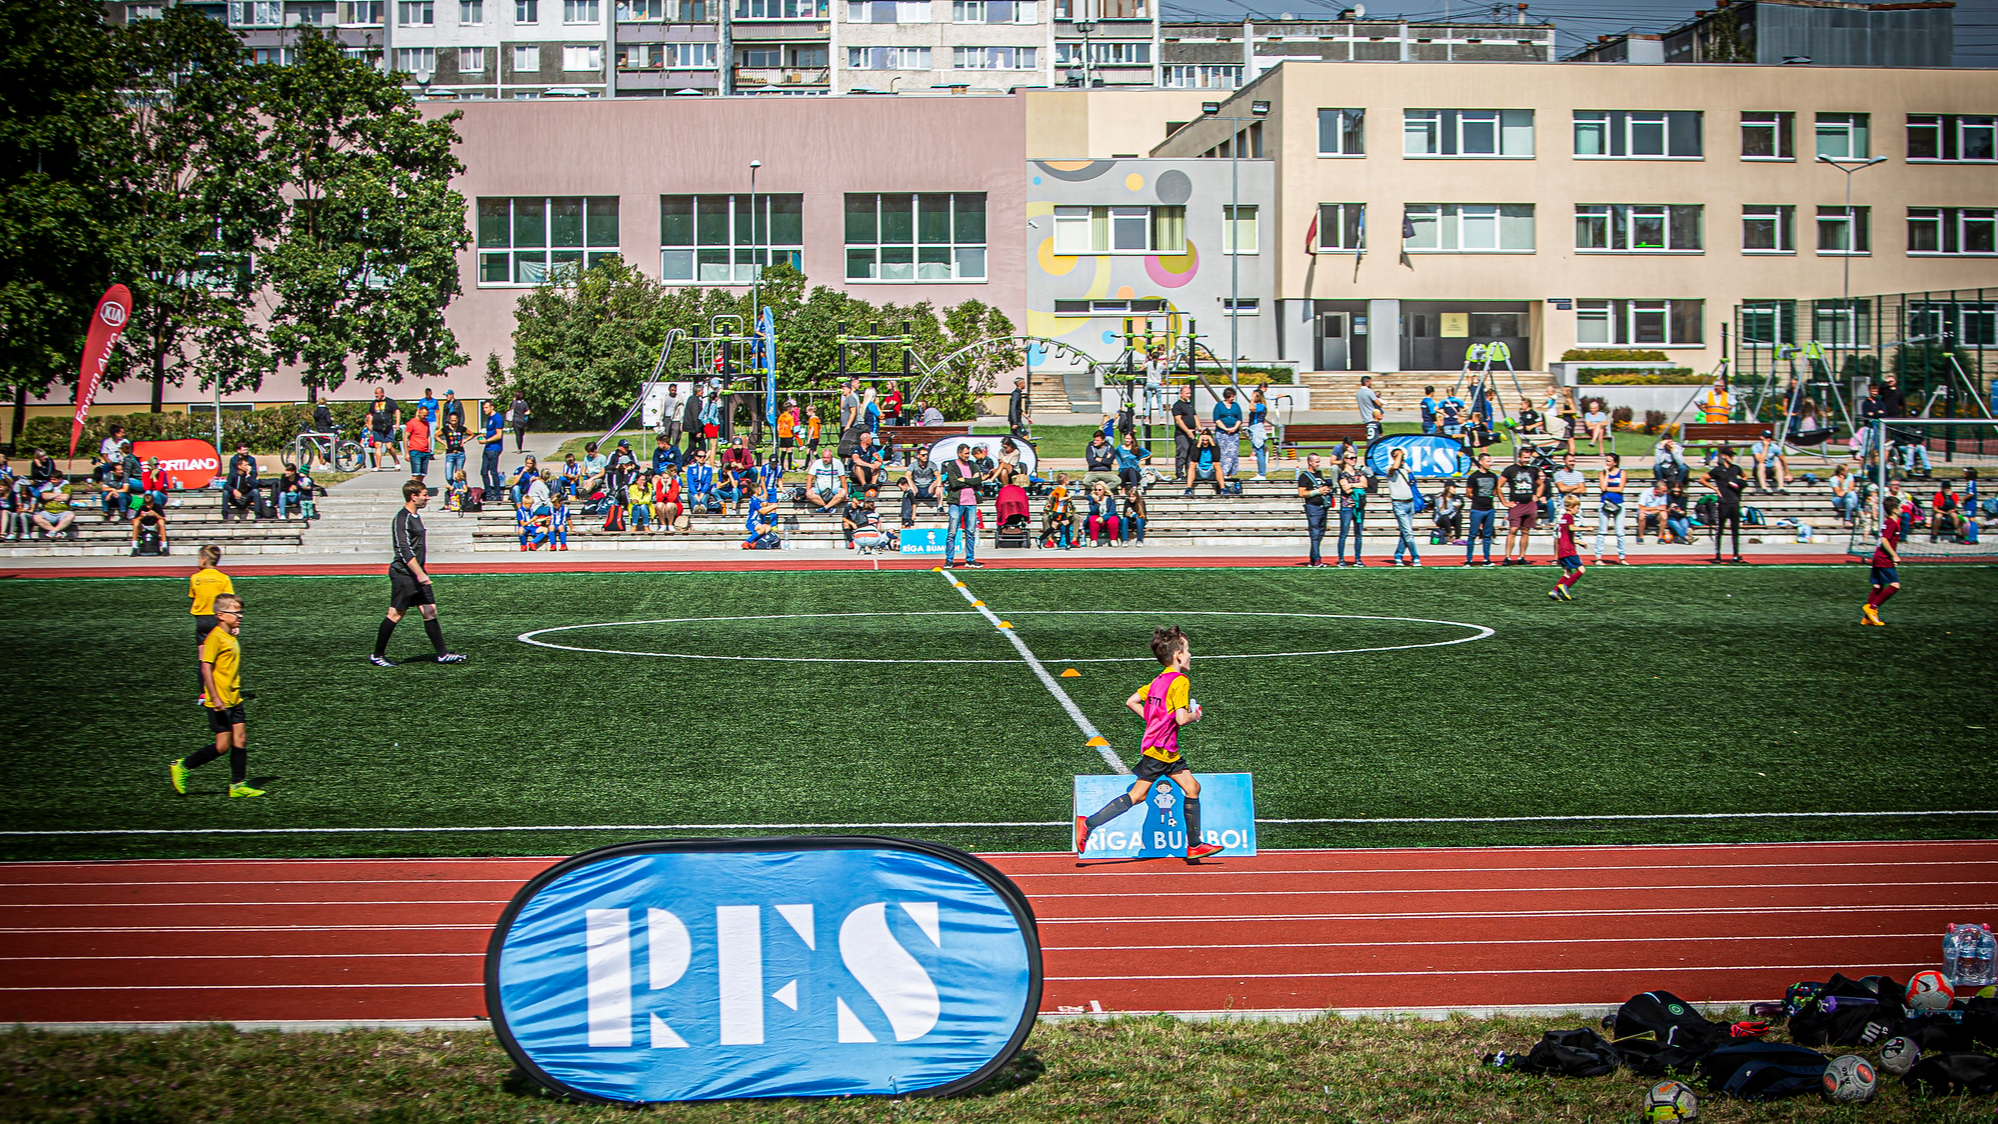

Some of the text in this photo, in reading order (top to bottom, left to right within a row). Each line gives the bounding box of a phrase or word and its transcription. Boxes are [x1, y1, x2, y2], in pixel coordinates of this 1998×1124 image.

[103, 304, 122, 323] KIA
[75, 332, 118, 425] Forum Auto
[140, 458, 217, 473] SORTLAND
[1086, 828, 1249, 851] RĪGA BUBO!
[586, 902, 942, 1048] RFS
